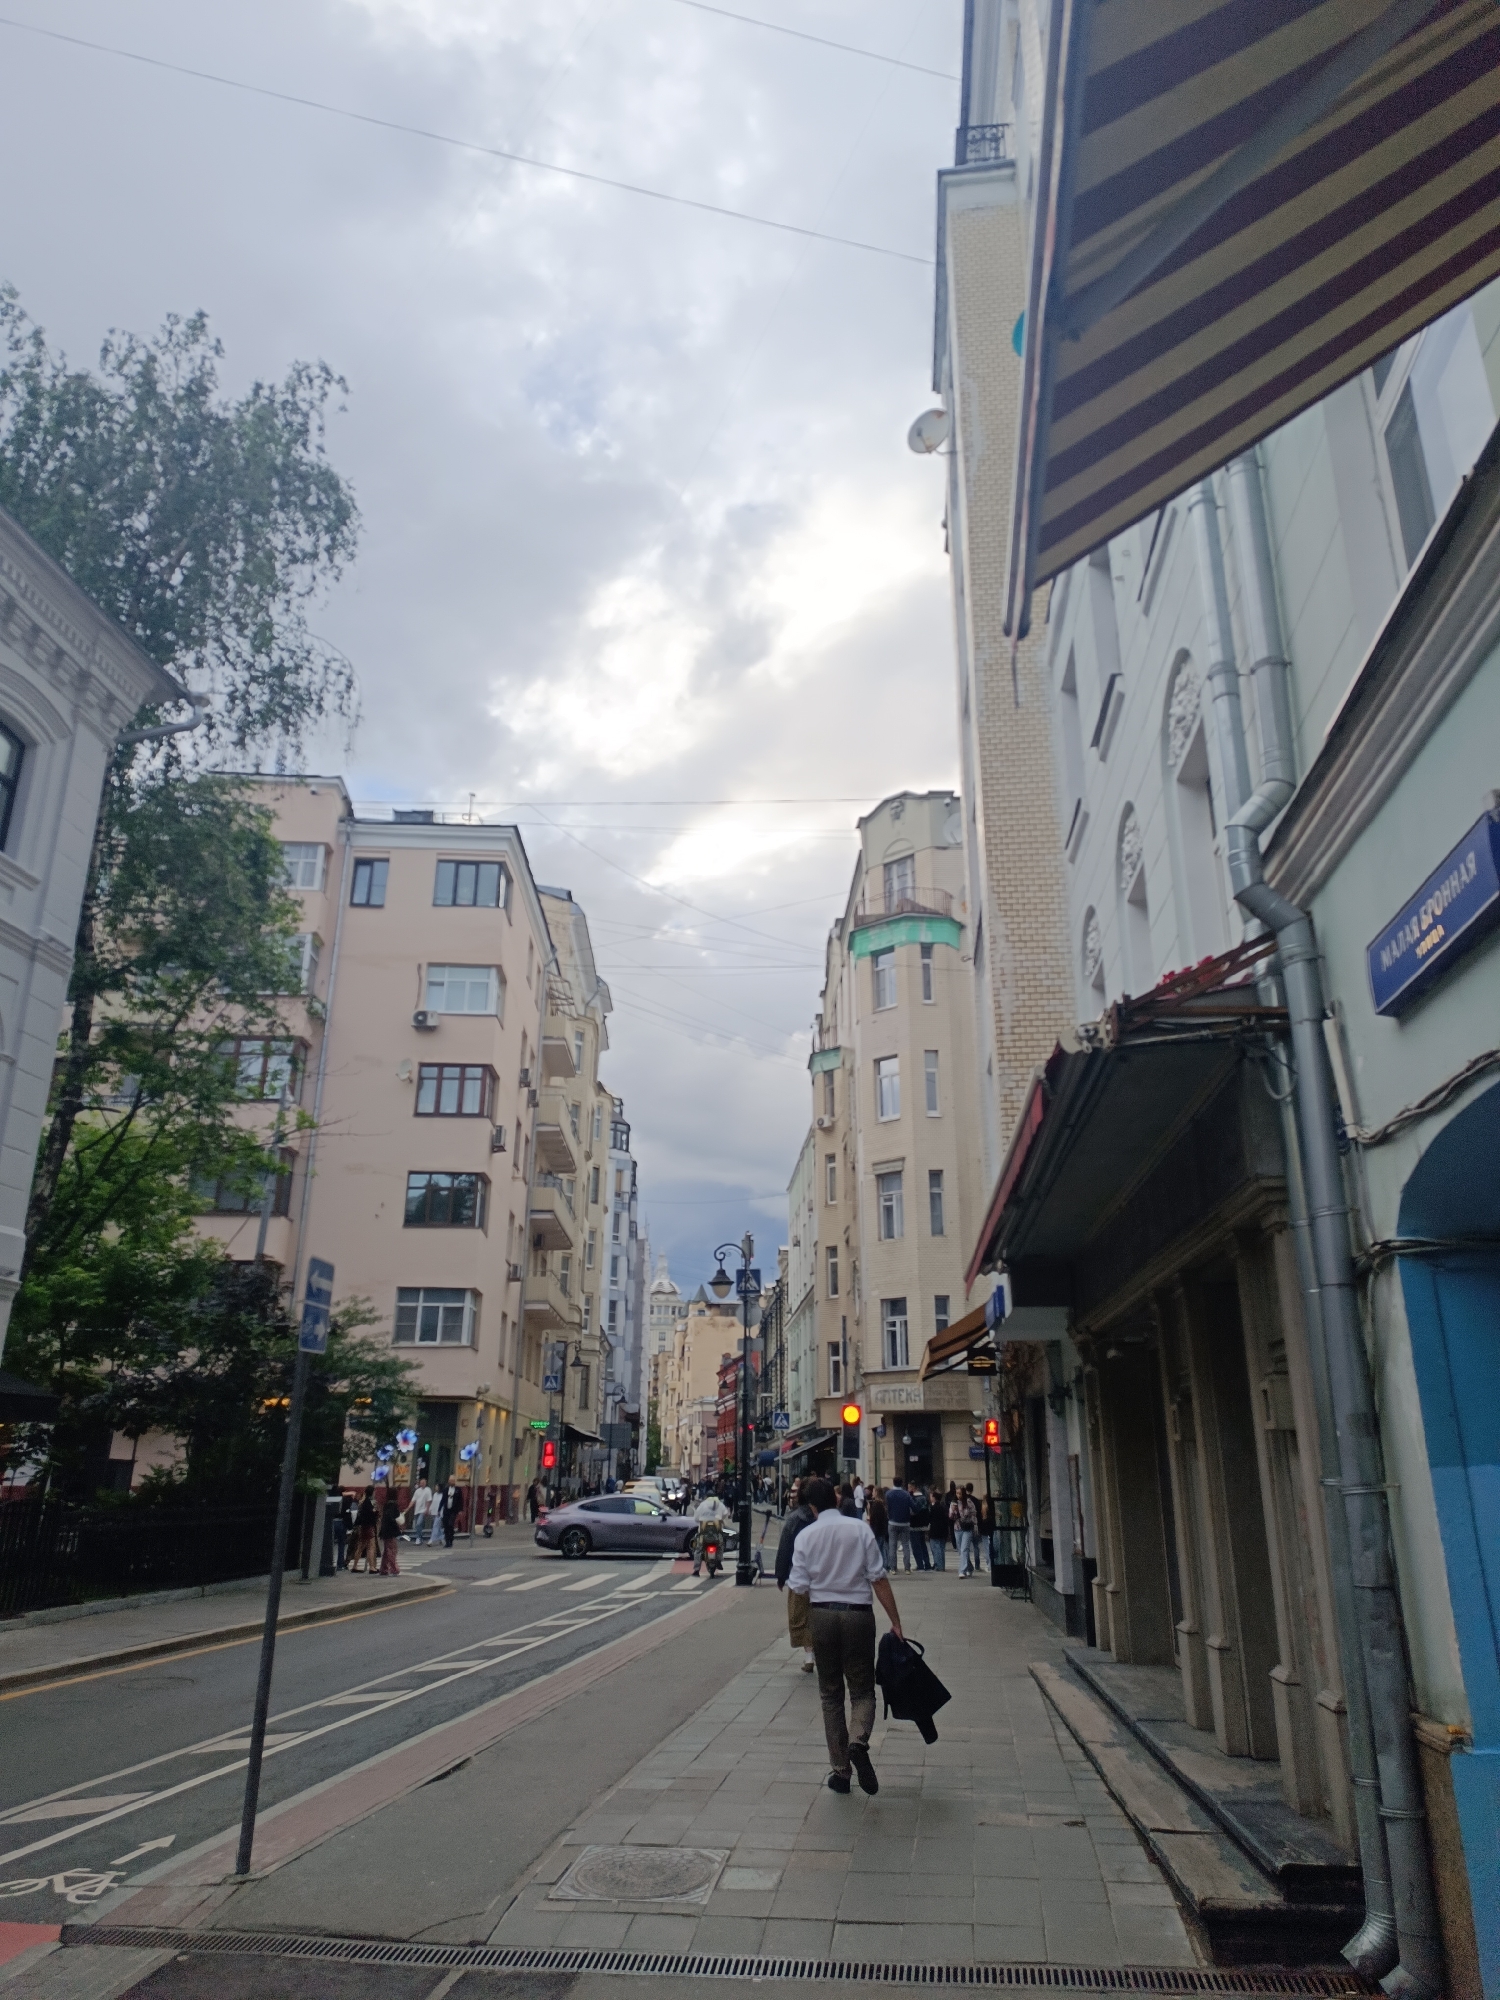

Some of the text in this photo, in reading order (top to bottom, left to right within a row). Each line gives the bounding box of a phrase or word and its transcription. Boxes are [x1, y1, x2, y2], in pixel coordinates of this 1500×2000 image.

[1380, 851, 1477, 972] МАЛАЯ БРОННАЯ
[874, 1388, 922, 1405] АПТЕКА
